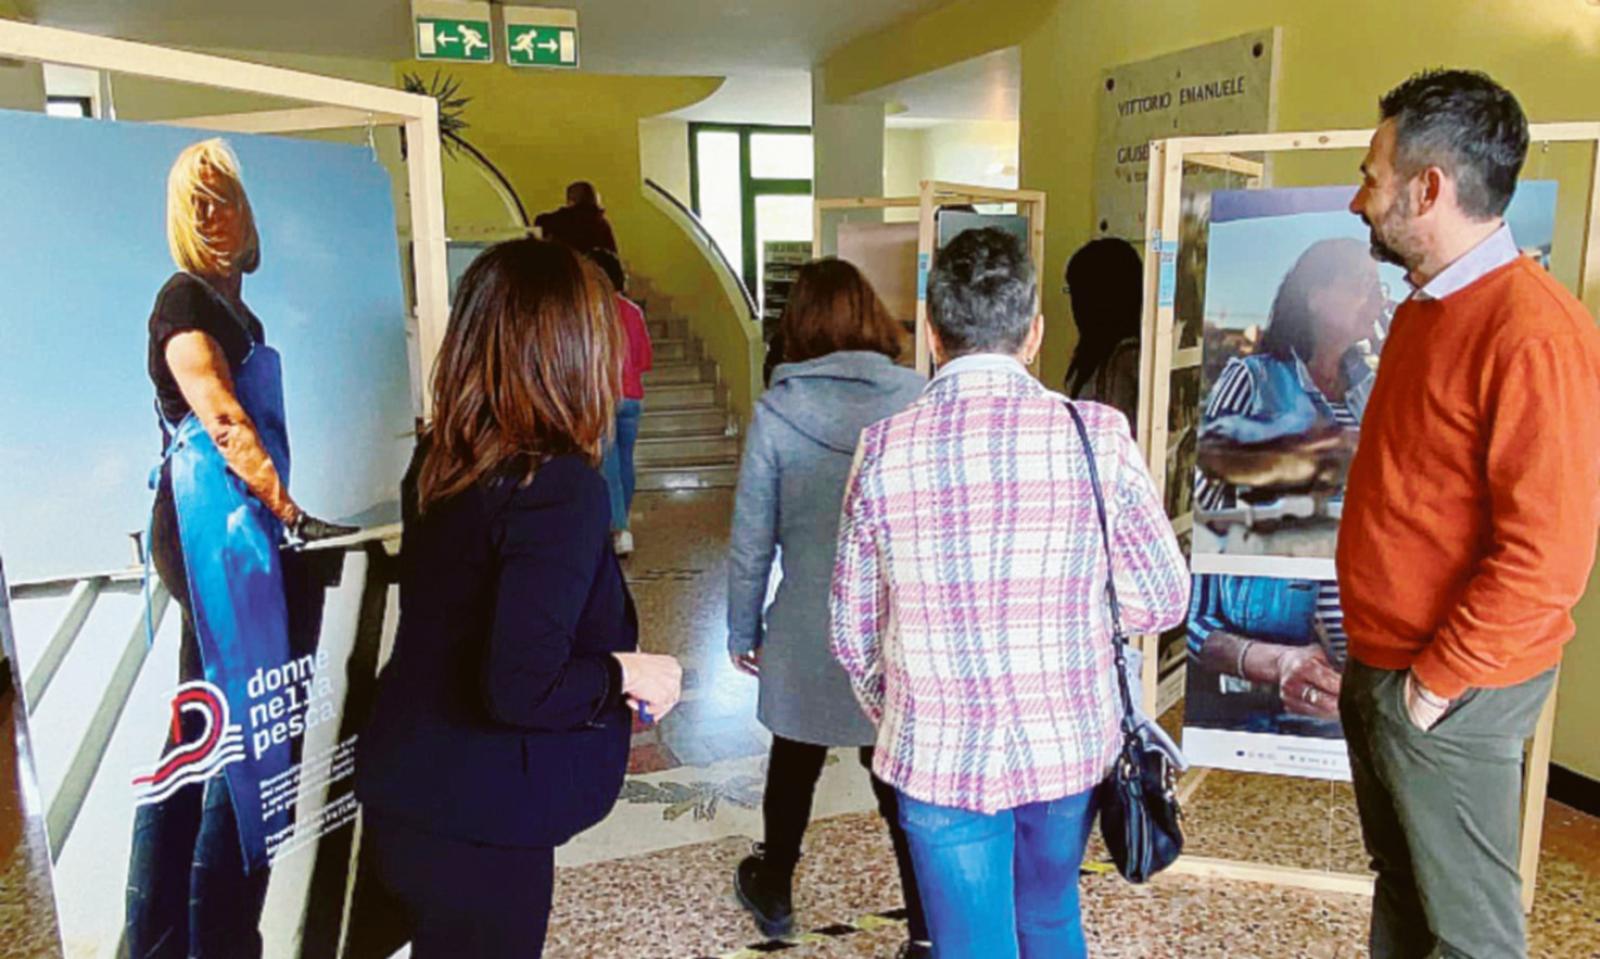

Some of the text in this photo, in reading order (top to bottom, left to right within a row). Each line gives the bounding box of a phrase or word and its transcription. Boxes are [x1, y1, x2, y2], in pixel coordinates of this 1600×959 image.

[1118, 76, 1245, 117] VITTORIO EMANUELE
[1117, 143, 1149, 164] GIUSE
[247, 649, 329, 699] donne
[250, 676, 333, 728] nella
[253, 701, 337, 761] pesca
